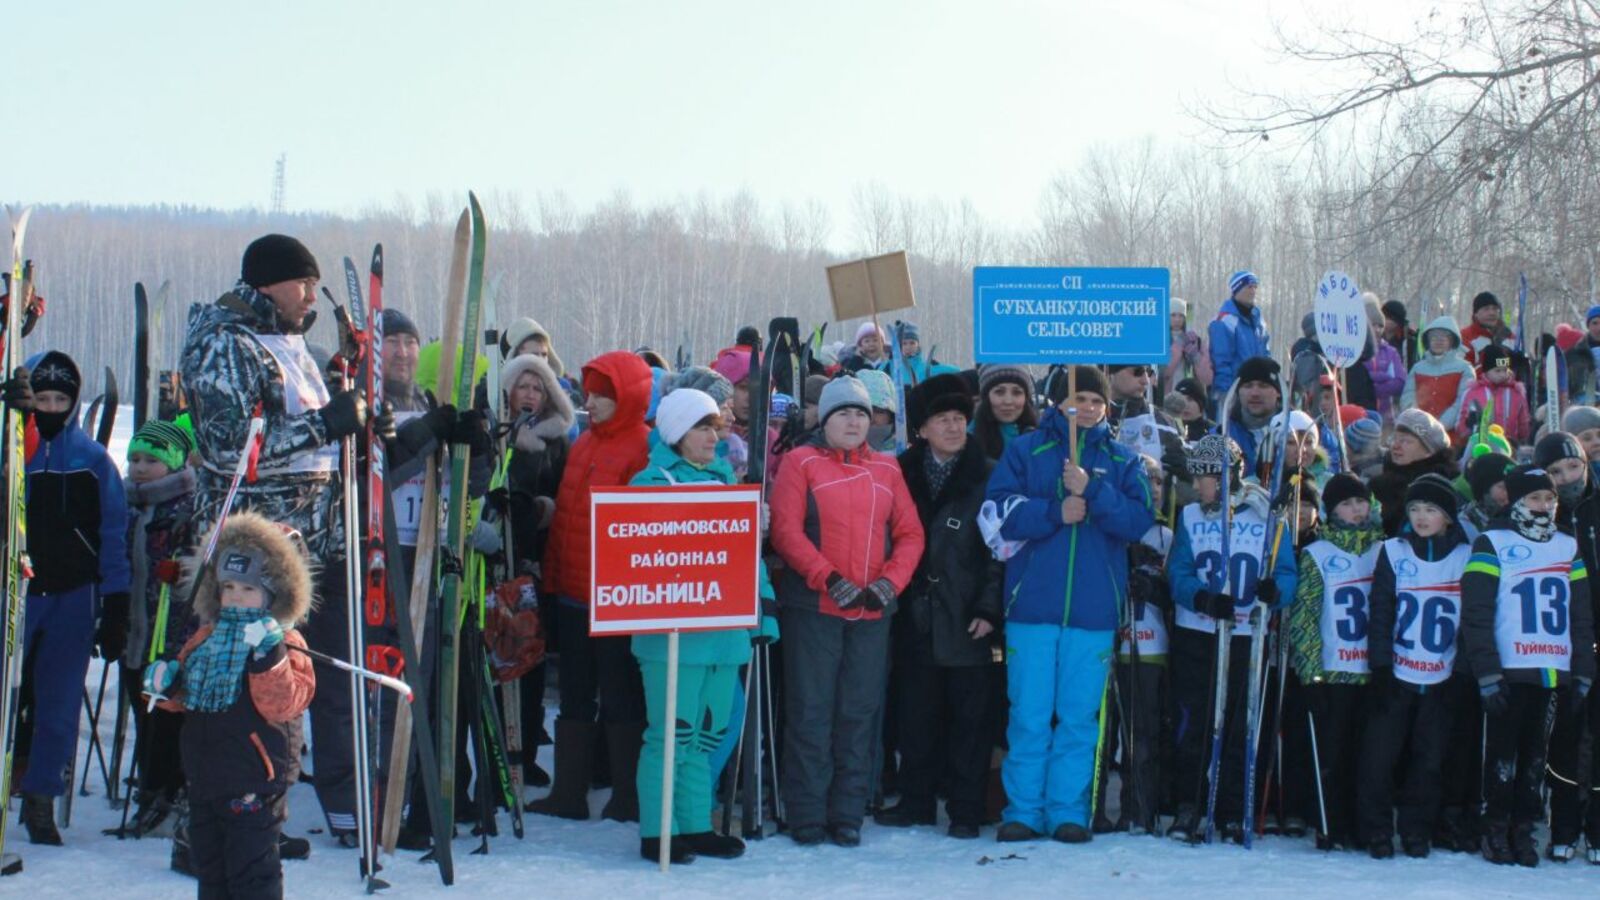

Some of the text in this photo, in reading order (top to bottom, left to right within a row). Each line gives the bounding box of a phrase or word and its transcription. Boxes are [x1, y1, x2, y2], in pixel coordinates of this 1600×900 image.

[1061, 275, 1082, 290] СП
[1320, 275, 1358, 299] МБОУ
[993, 297, 1157, 317] СУБХАНКУЛОВСКИЙ
[1027, 321, 1123, 338] СЕЛЬСОВЕТ
[1320, 312, 1338, 335] СОШ
[607, 518, 750, 539] СЕРАФИМОВСКАЯ
[630, 549, 728, 568] РАЙОННАЯ
[1195, 549, 1259, 607] 30
[596, 581, 722, 606] БОЛЬНИЦА
[1510, 575, 1567, 636] 13
[1394, 592, 1456, 654] 26
[1337, 648, 1368, 661] Туйм
[1513, 641, 1568, 656] Туймазы
